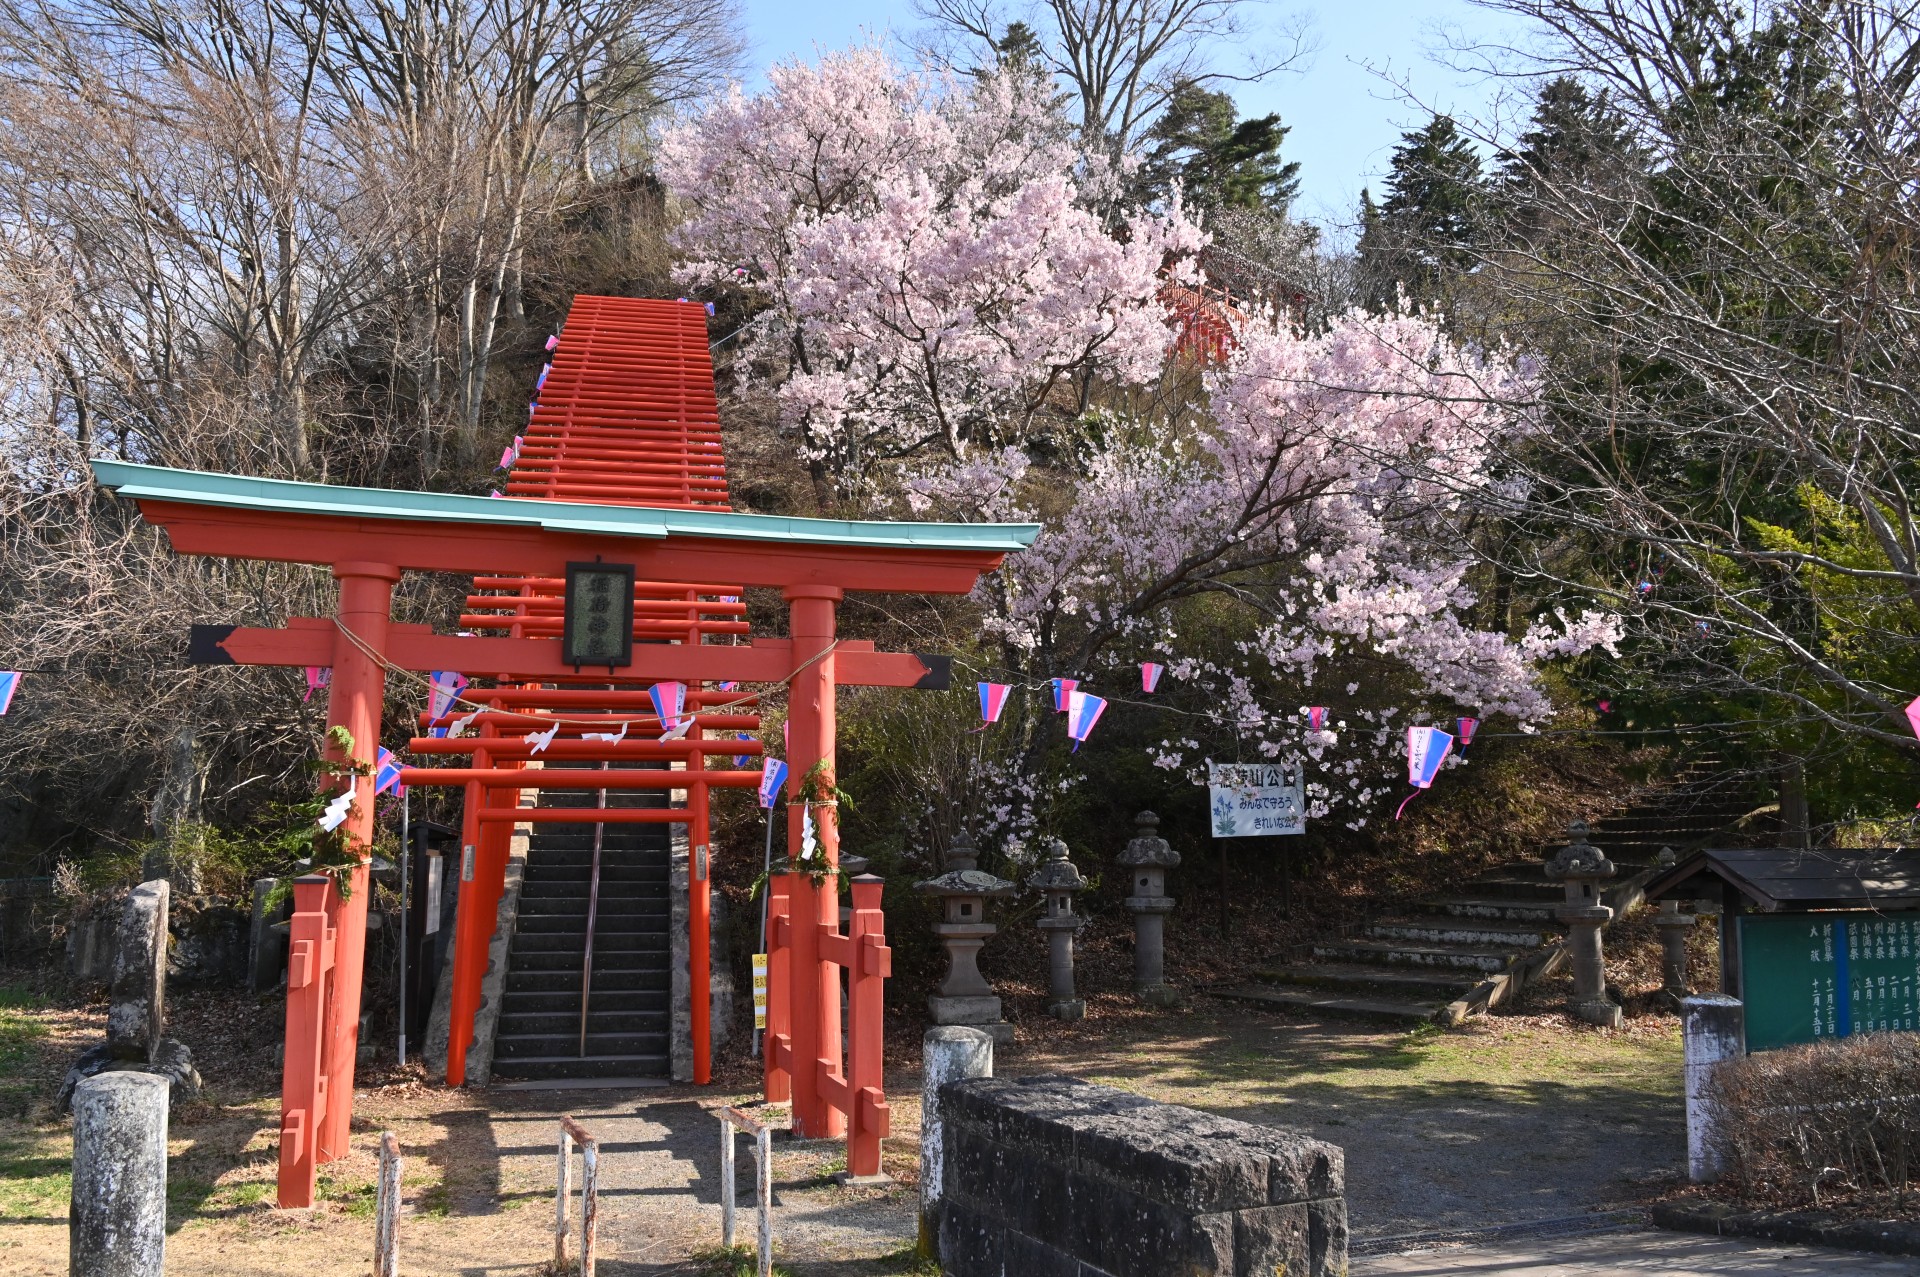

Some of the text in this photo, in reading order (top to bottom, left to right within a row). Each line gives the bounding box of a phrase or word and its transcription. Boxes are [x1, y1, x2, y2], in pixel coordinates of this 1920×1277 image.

[1239, 797, 1293, 810] みんなで守ろう
[1861, 922, 1872, 959] 小満祭
[1874, 922, 1885, 959] 例大祭
[1886, 922, 1897, 959] 初午祭
[1812, 978, 1822, 1035] 十二月十五日
[1826, 977, 1835, 1034] 十一月二十三日
[1902, 976, 1912, 1029] 一月三日
